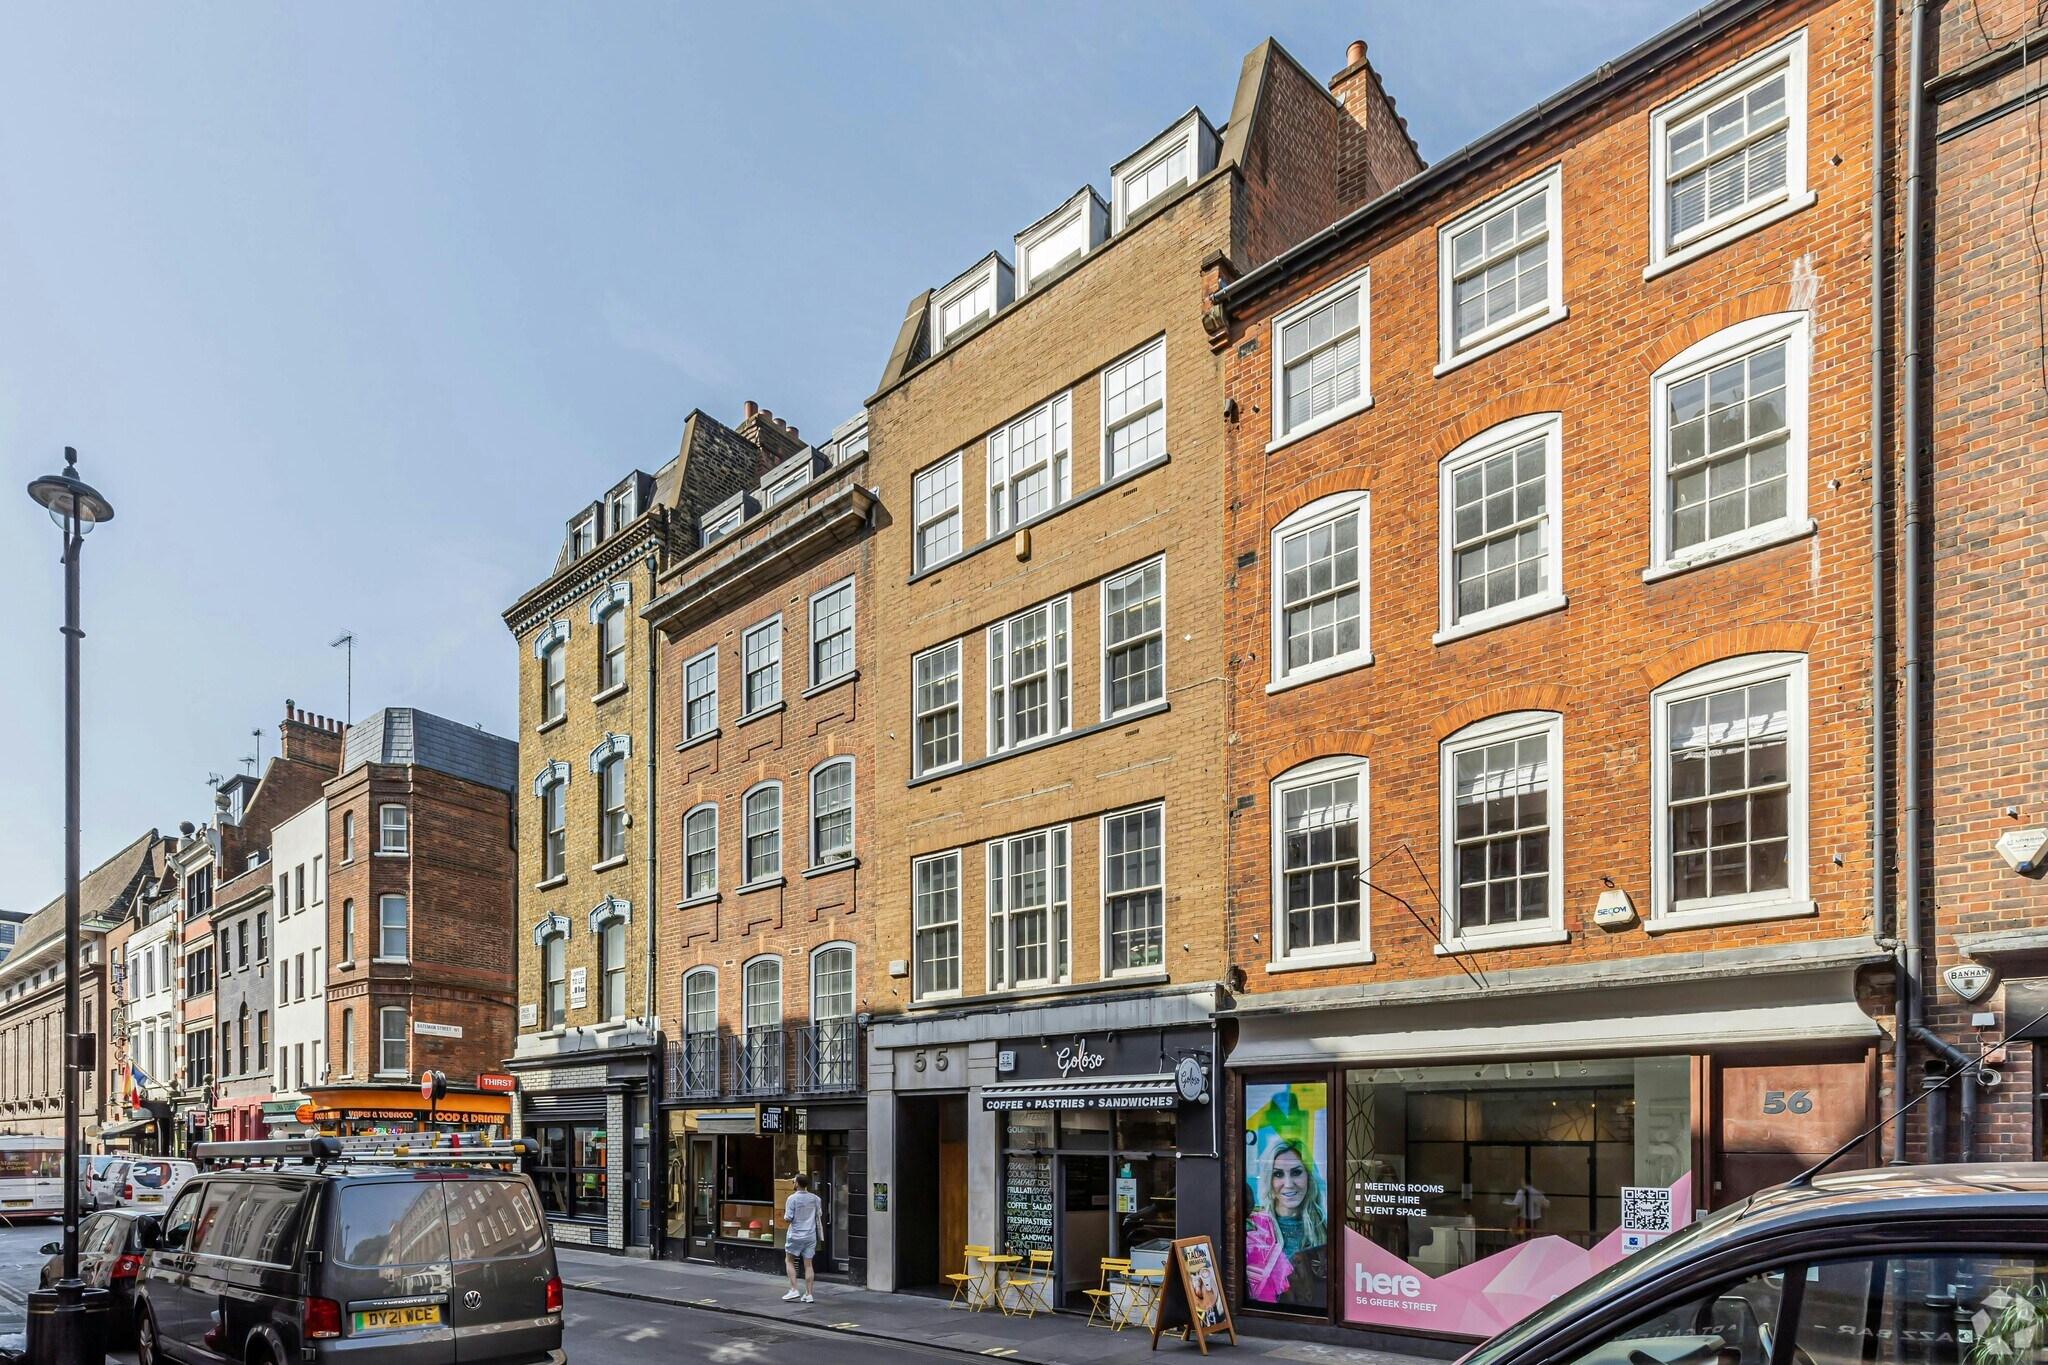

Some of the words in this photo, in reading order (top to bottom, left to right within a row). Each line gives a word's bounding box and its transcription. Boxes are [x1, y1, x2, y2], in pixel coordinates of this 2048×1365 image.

[1597, 906, 1627, 916] SECOM
[1951, 970, 1988, 980] BANHAM
[416, 1023, 437, 1031] BATEMAN
[483, 1078, 513, 1087] THIRST
[986, 1100, 1023, 1110] COFFEE
[1034, 1098, 1085, 1109] PASTRIES
[1098, 1096, 1173, 1108] SANDWICHES
[1763, 1089, 1813, 1114] 56
[348, 1110, 371, 1118] VAPES
[378, 1111, 414, 1119] TOBACCO
[462, 1113, 469, 1122] &
[471, 1114, 505, 1124] DRINKS
[1007, 1186, 1031, 1194] FRULLATI
[1364, 1182, 1406, 1192] MEETING
[1407, 1184, 1444, 1193] ROOMS
[1007, 1193, 1028, 1201] FRESH
[1364, 1194, 1396, 1204] VENUE
[1397, 1195, 1420, 1204] HIRE
[1007, 1201, 1028, 1210] COFFEE
[1032, 1202, 1053, 1211] SALAD
[1364, 1206, 1395, 1215] EVENT
[1396, 1207, 1427, 1217] SPACE
[1007, 1216, 1025, 1224] FRESH
[1025, 1217, 1052, 1226] PASTRIES
[1007, 1223, 1018, 1232] HOT
[1019, 1224, 1051, 1234] CHOCOLATE
[1021, 1233, 1053, 1242] SANDWICH
[1355, 1262, 1421, 1298] here
[1356, 1296, 1368, 1305] 56
[1369, 1298, 1400, 1309] GREEK
[1402, 1301, 1438, 1312] STREET
[369, 1311, 402, 1326] DY21
[405, 1307, 433, 1322] WCE
